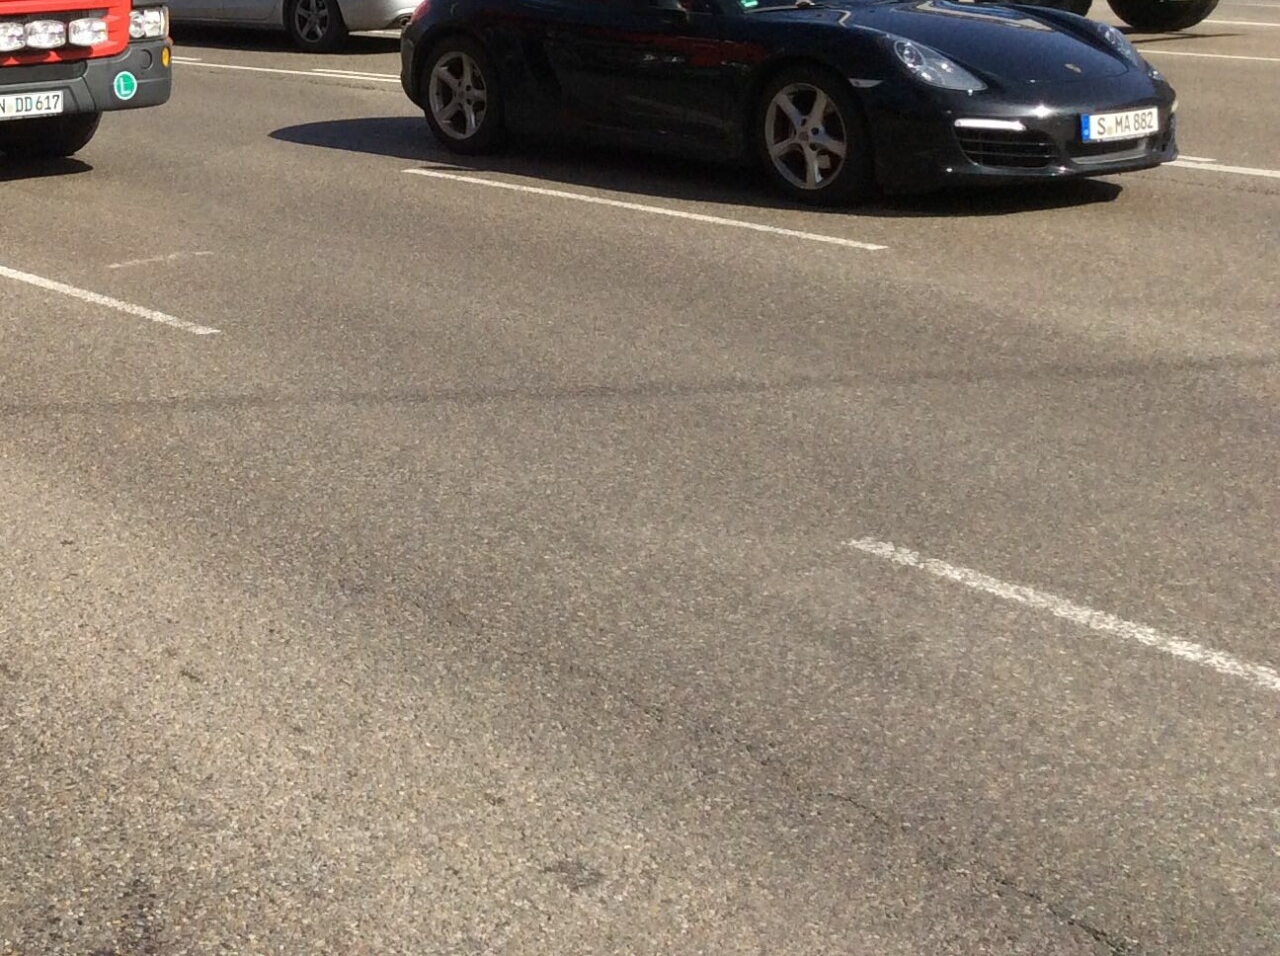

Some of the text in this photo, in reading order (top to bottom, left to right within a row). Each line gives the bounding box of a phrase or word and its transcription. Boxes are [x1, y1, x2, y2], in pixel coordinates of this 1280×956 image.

[120, 76, 131, 94] L
[15, 96, 33, 113] DD
[35, 95, 60, 110] 617
[1097, 111, 1153, 135] S MA 882
